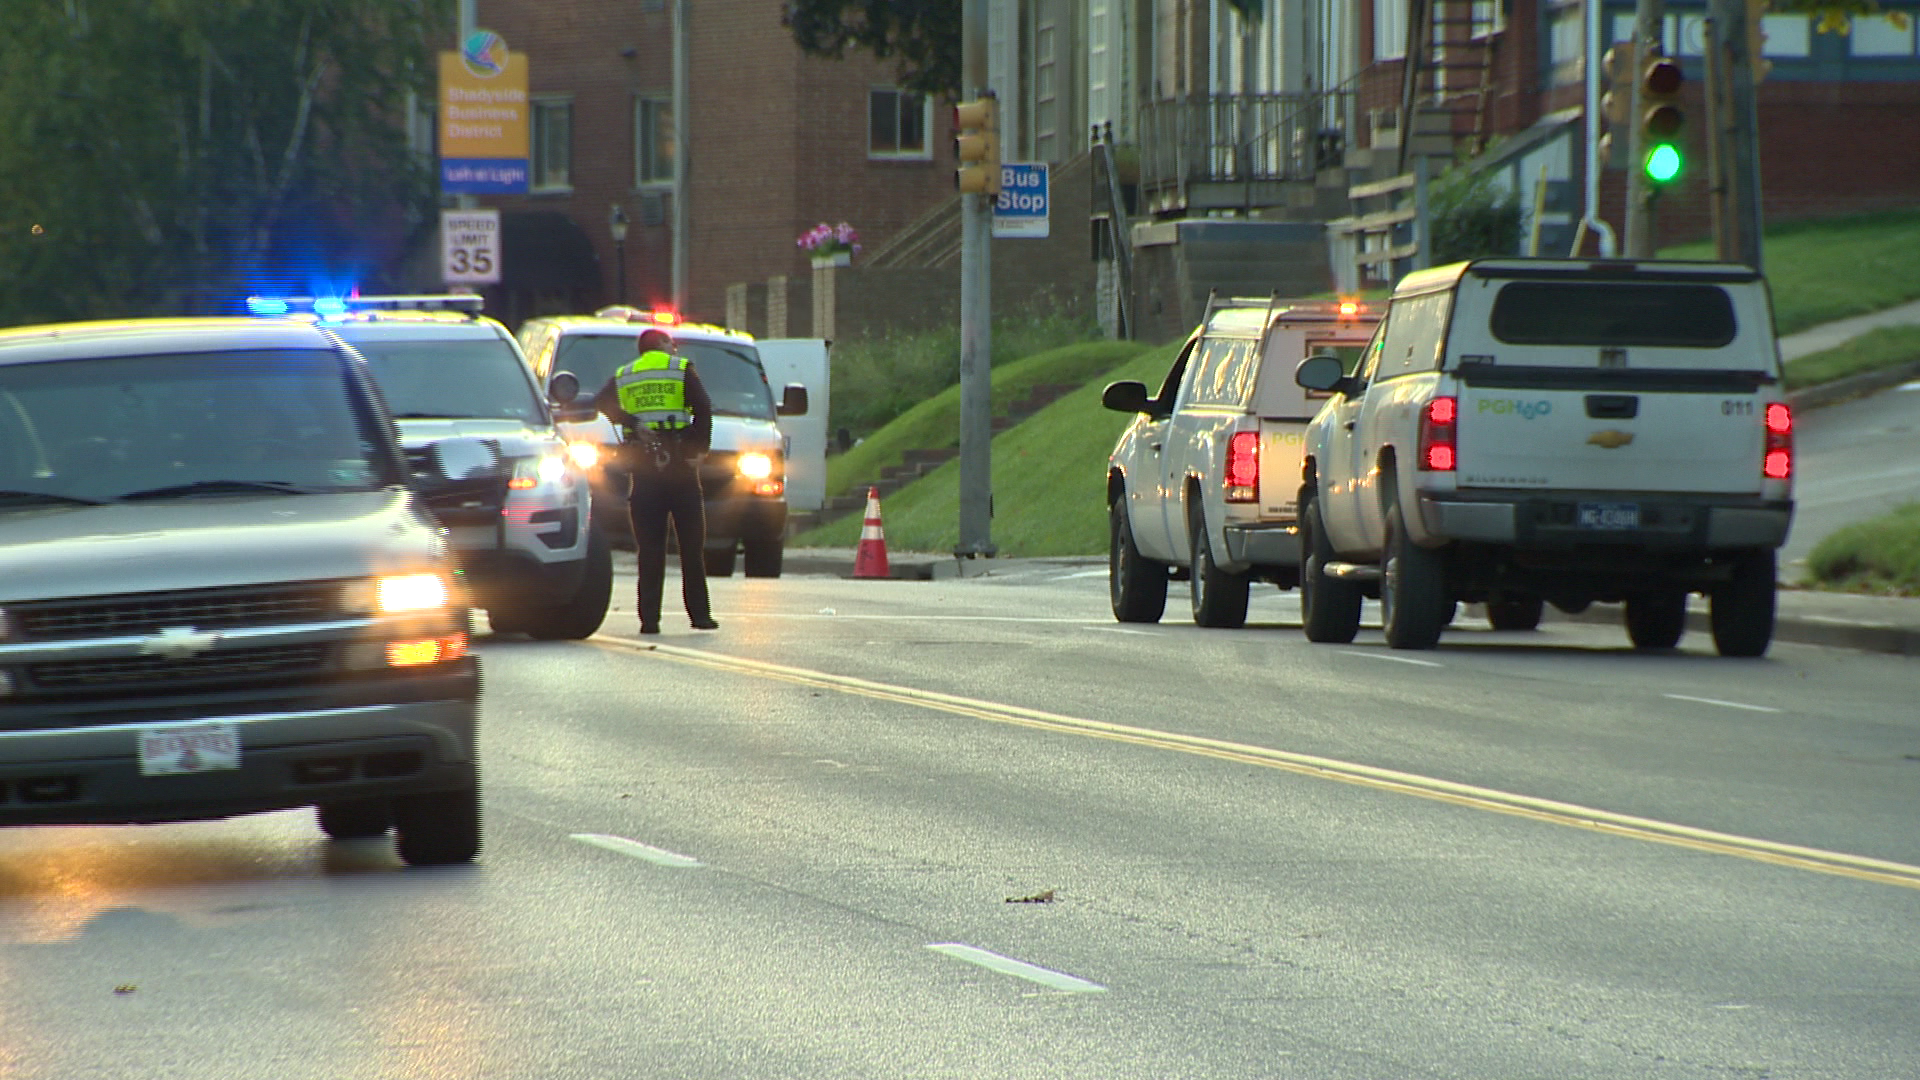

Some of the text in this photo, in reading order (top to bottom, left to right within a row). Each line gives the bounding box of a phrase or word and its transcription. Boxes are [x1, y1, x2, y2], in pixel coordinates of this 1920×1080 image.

[448, 105, 518, 121] Business
[448, 123, 503, 139] District
[1001, 167, 1040, 188] Bus
[997, 190, 1045, 213] Stop
[448, 220, 496, 232] SPEED
[452, 233, 489, 246] LIMIT
[451, 248, 493, 275] 35
[635, 395, 666, 408] POLICE
[1720, 400, 1753, 415] 011
